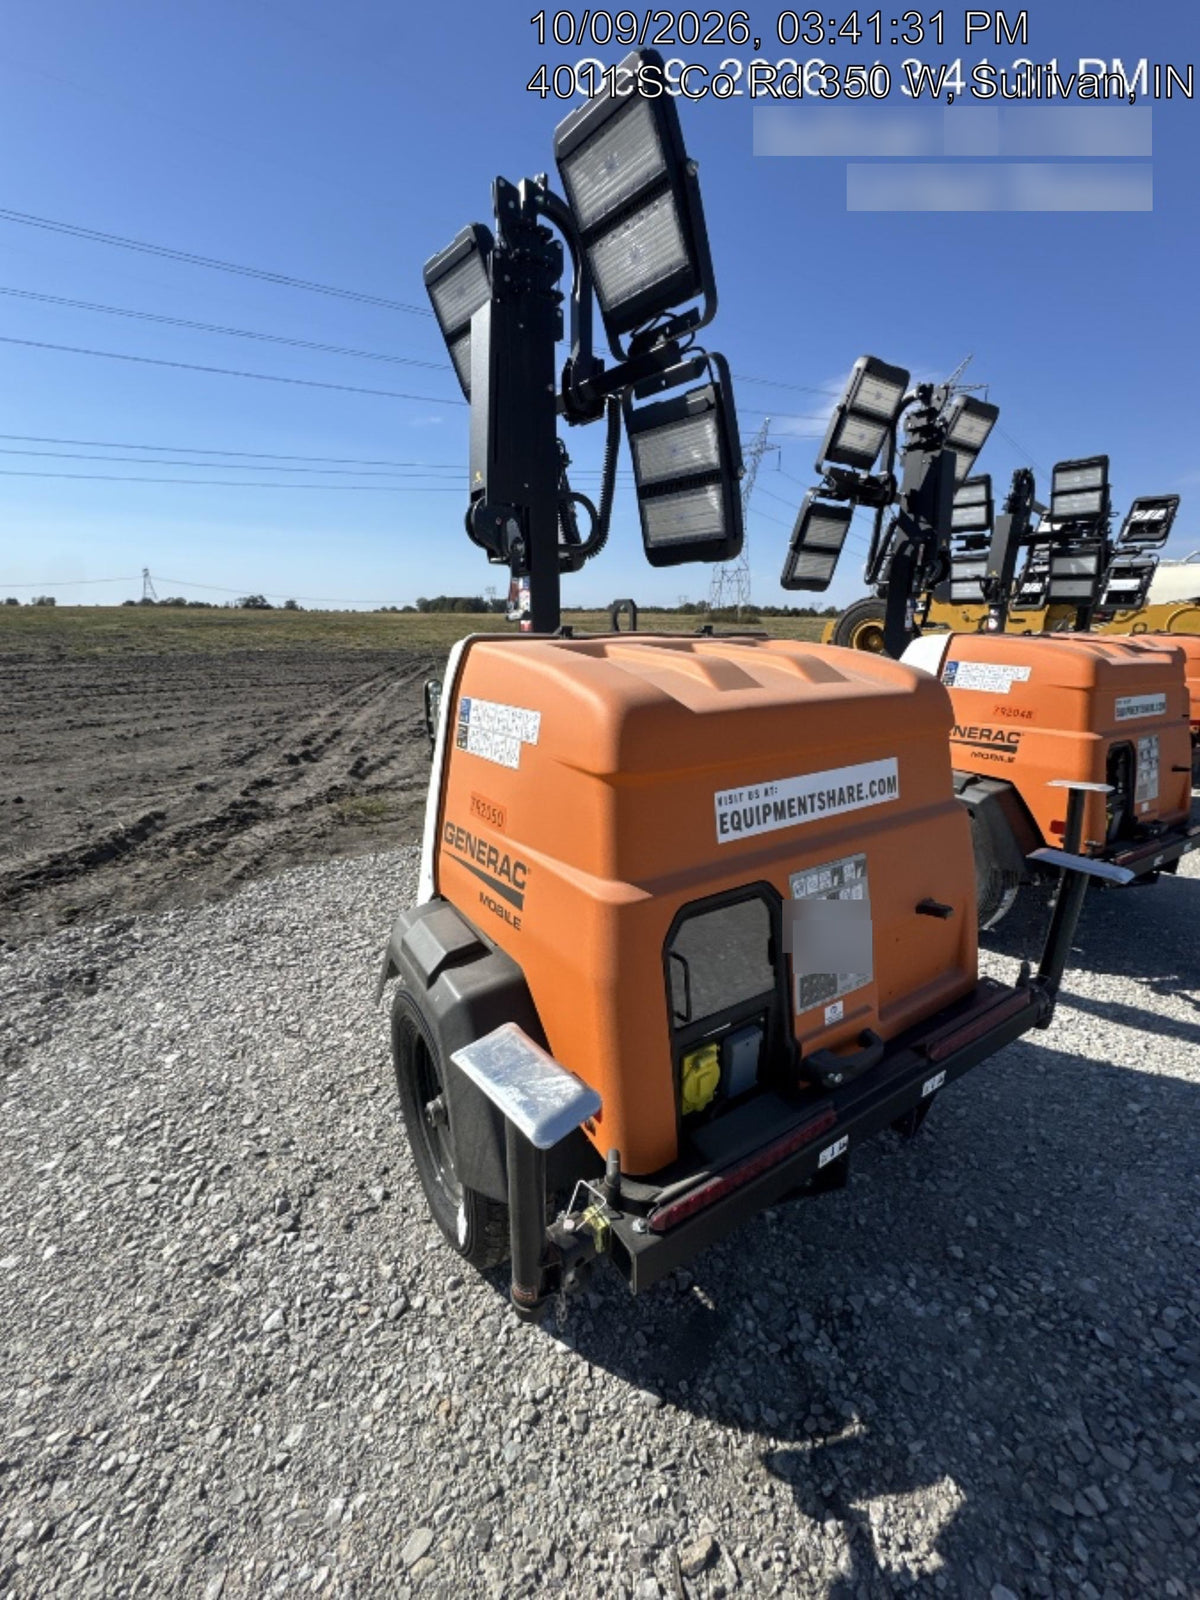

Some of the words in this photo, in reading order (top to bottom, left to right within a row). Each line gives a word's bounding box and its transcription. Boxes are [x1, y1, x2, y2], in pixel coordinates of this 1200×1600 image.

[949, 725, 1021, 744] NERAC
[717, 792, 743, 807] VISIT
[748, 789, 760, 801] US
[719, 775, 897, 834] EQUIPMENTSHARE.COM
[444, 821, 528, 890] GENERAC
[480, 892, 522, 931] MOBILE
